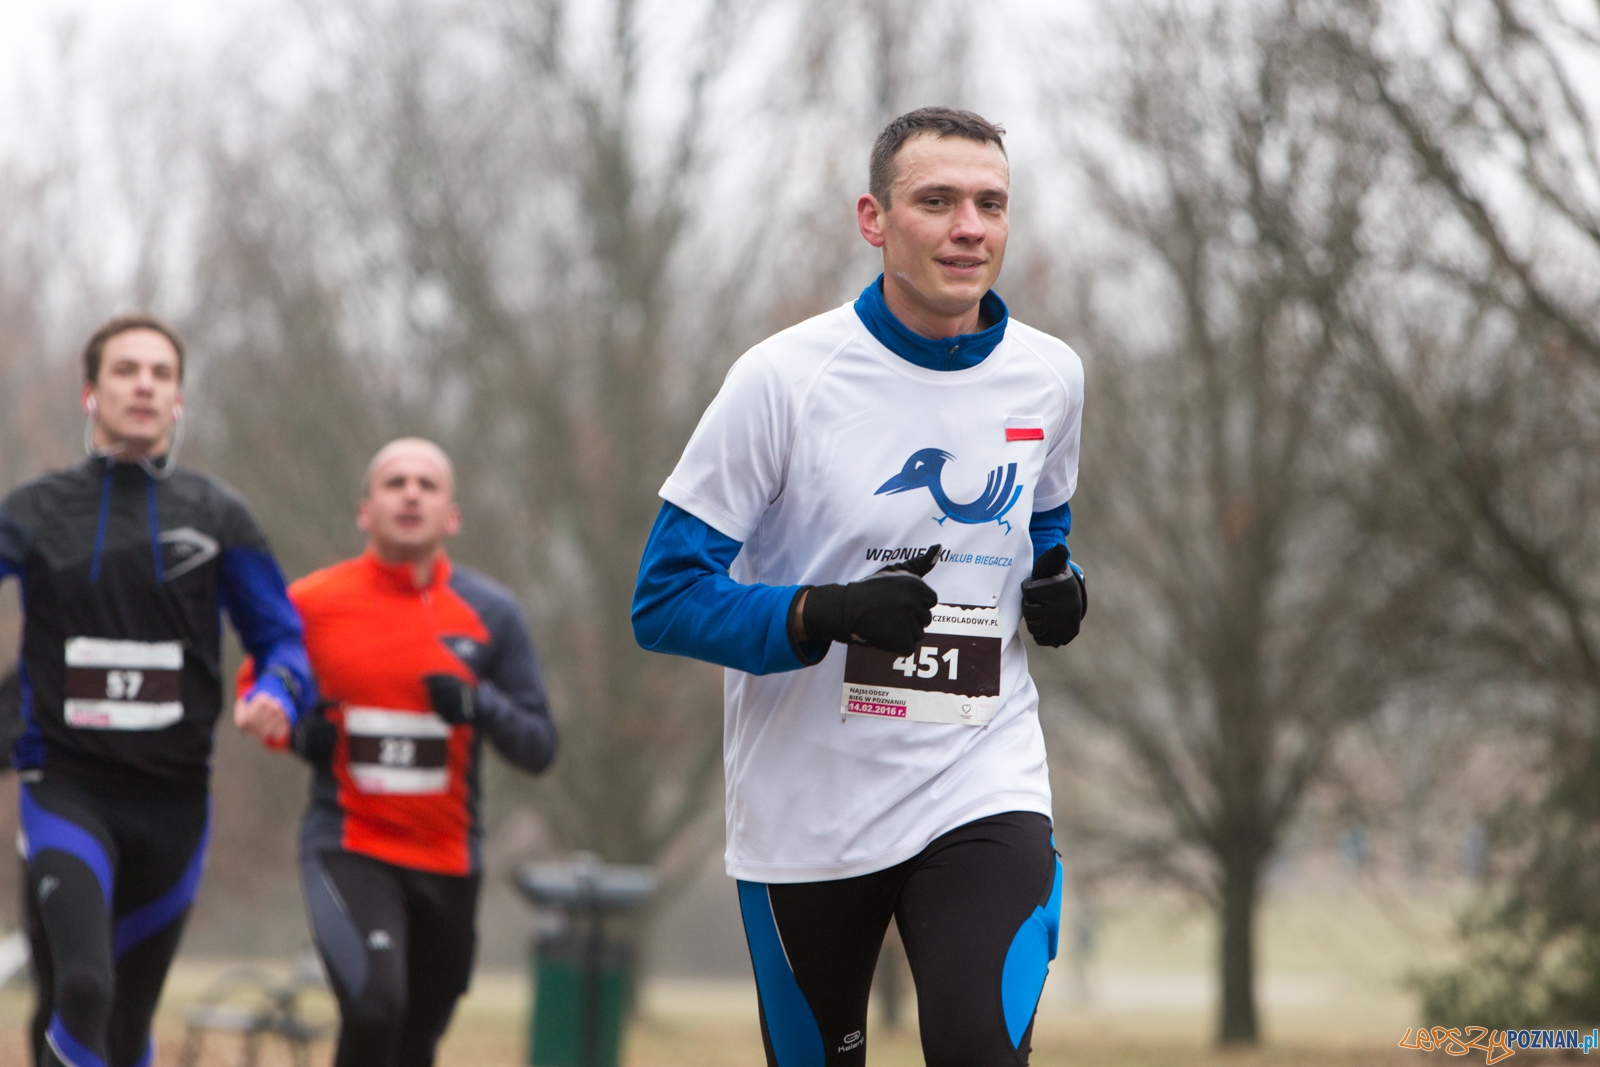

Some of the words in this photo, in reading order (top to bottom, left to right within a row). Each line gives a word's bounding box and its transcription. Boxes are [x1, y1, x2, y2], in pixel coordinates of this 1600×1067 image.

[866, 548, 951, 562] WRONIEKI
[949, 554, 972, 564] KLUB
[974, 556, 1012, 567] BIEGACZA
[932, 615, 998, 627] CZEKOLADOWY.PL
[892, 646, 959, 680] 451
[850, 687, 889, 697] NAJSŁODSZY
[873, 697, 906, 706] POZNANIU
[849, 703, 896, 716] 14.02.2016
[897, 709, 906, 717] r.
